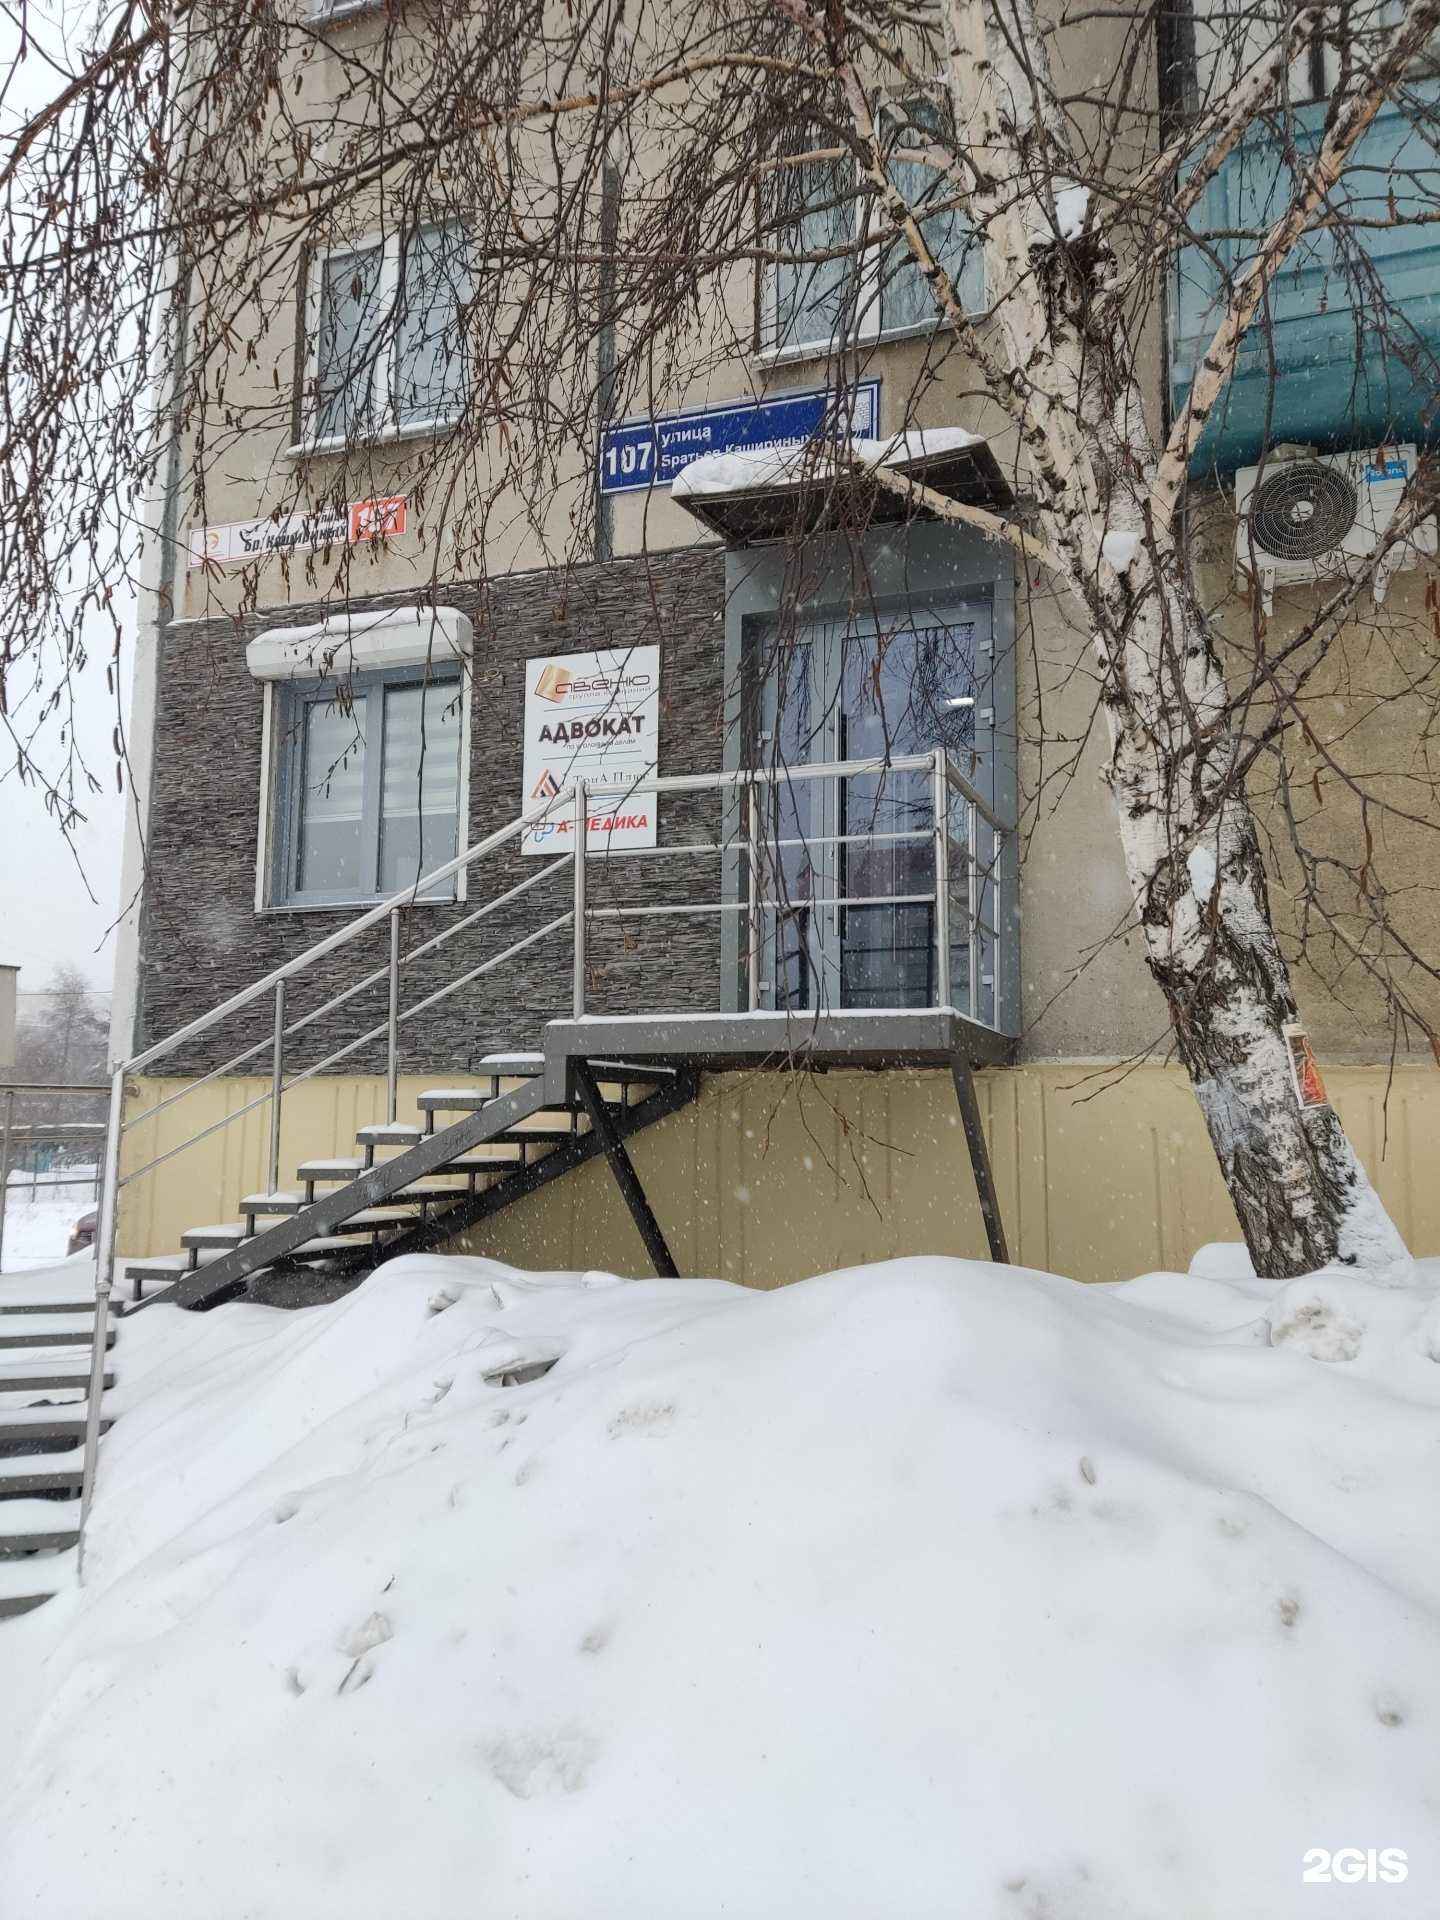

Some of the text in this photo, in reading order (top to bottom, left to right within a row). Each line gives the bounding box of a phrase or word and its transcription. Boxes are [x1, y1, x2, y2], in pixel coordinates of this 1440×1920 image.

[661, 426, 712, 447] улица
[661, 434, 812, 469] Братьев Кашириных
[605, 442, 652, 476] 107
[538, 716, 646, 743] АДВОКАТ
